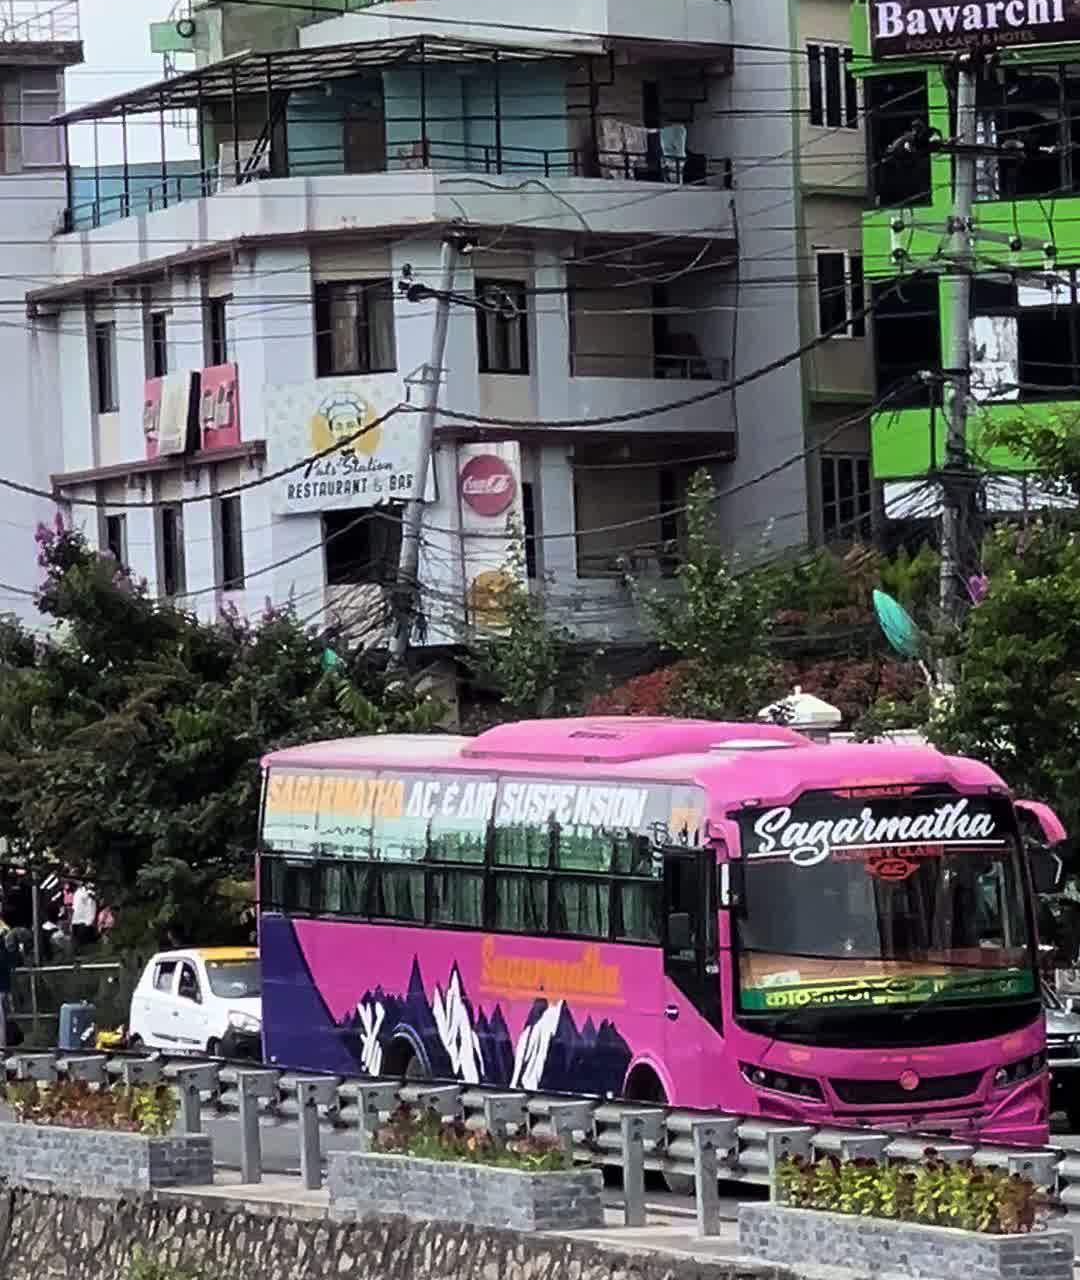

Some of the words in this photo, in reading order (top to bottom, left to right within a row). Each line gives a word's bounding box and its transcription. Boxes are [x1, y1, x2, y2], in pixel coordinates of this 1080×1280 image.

[905, 36, 943, 51] FOOD
[287, 477, 368, 500] RESTAURANT
[406, 780, 441, 818] AC
[496, 782, 649, 827] SUSPENSION
[753, 797, 996, 866] Sagarmatha
